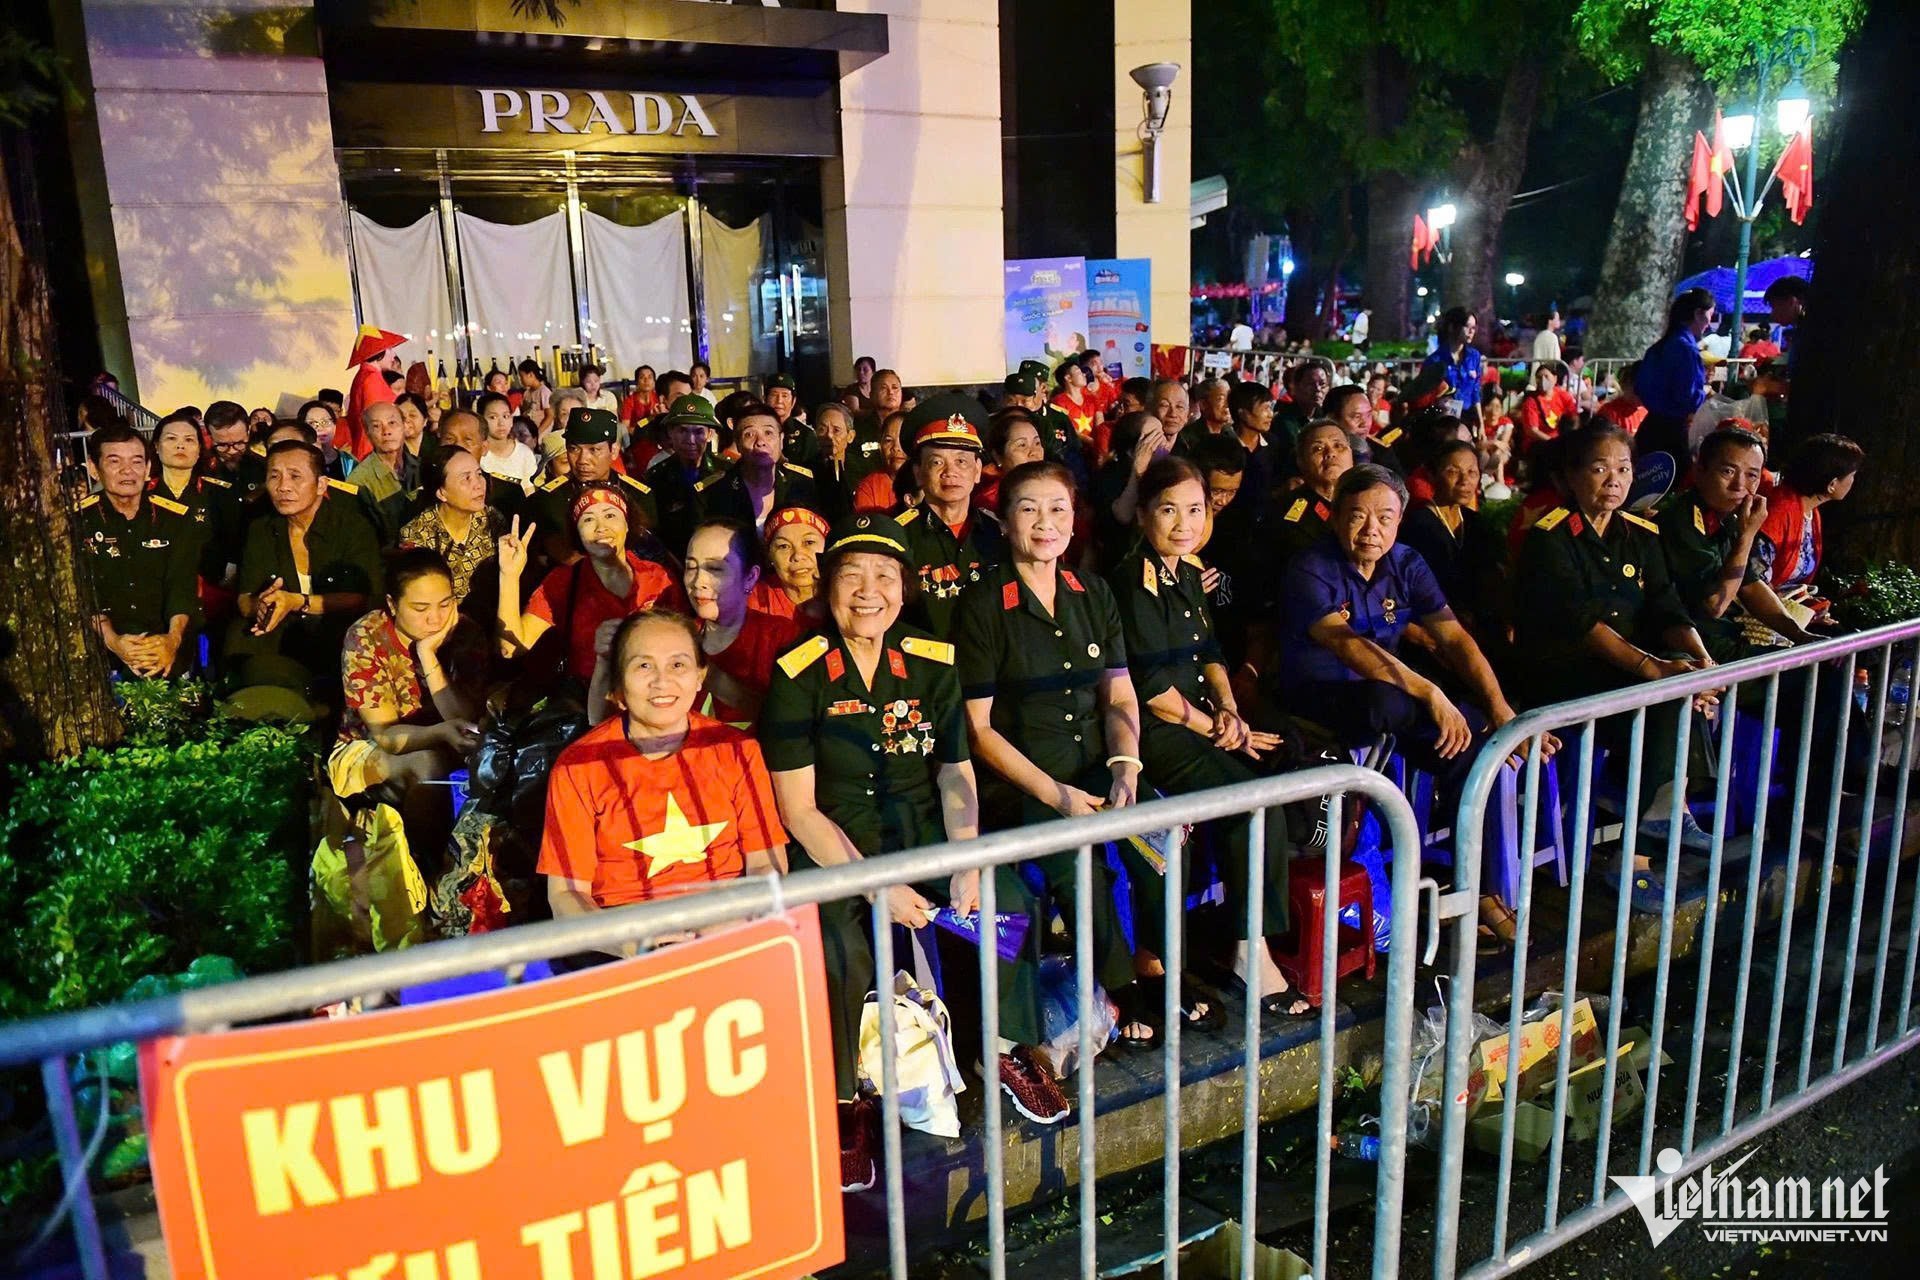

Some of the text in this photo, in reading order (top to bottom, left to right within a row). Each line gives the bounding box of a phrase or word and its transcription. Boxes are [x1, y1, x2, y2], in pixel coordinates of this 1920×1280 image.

[477, 88, 718, 137] PRADA
[241, 998, 768, 1217] KHU VỰC
[522, 1159, 752, 1280] TIÊN
